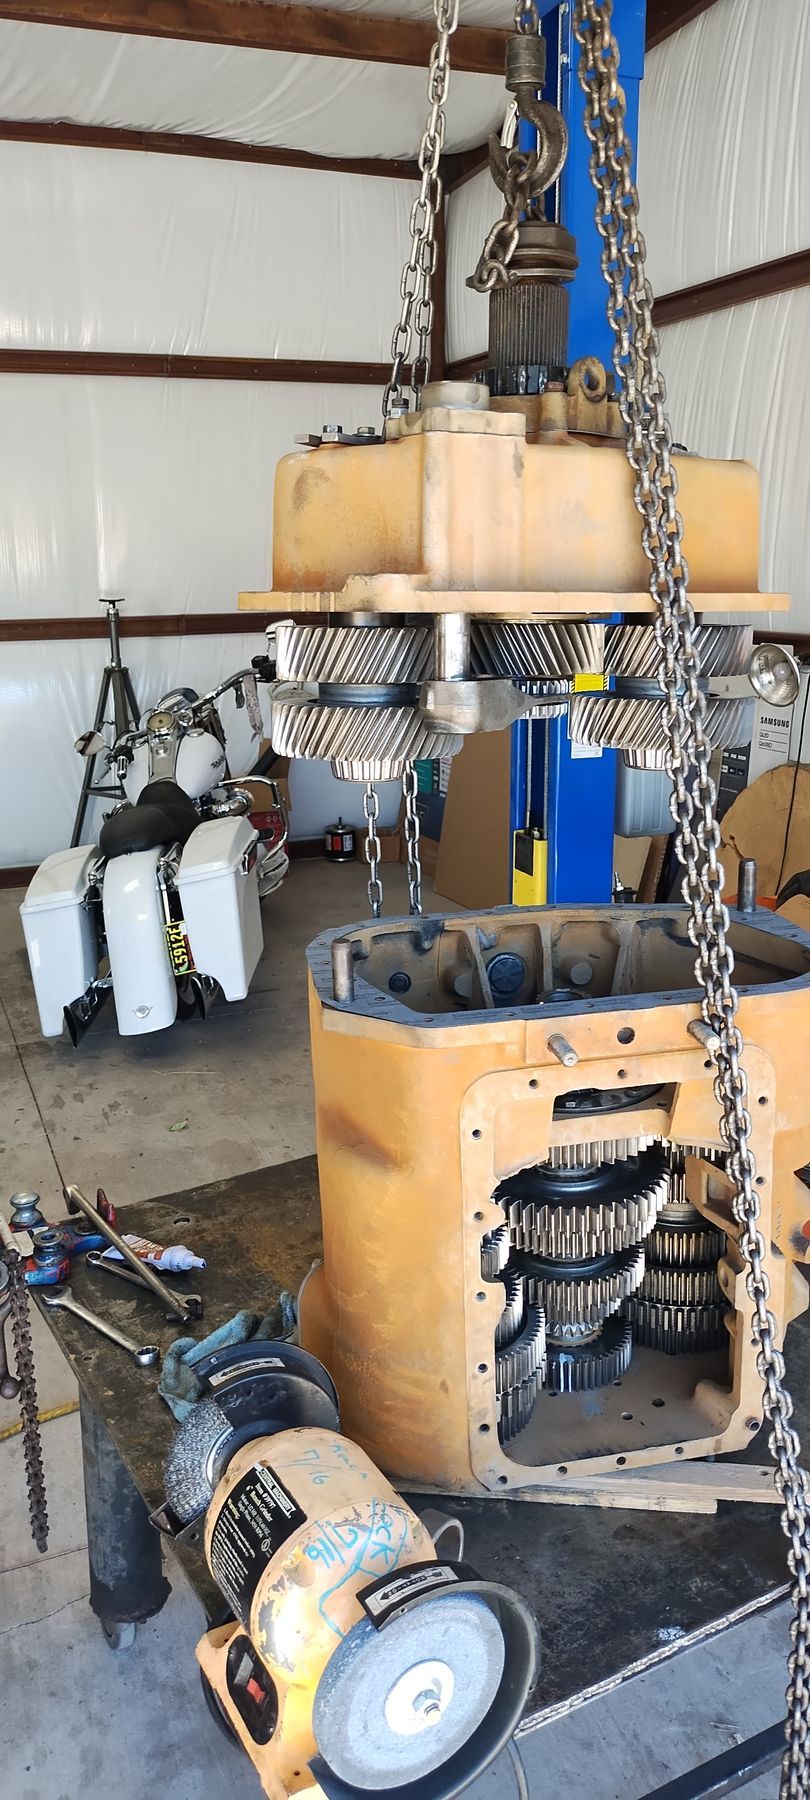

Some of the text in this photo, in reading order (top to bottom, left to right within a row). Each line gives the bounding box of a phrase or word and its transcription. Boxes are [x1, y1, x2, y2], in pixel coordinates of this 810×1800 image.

[760, 716, 790, 728] SAMSUNG
[250, 1490, 261, 1507] Bench
[259, 1503, 273, 1522] Grinder
[260, 1470, 292, 1511] CENTRAL MACHINERY
